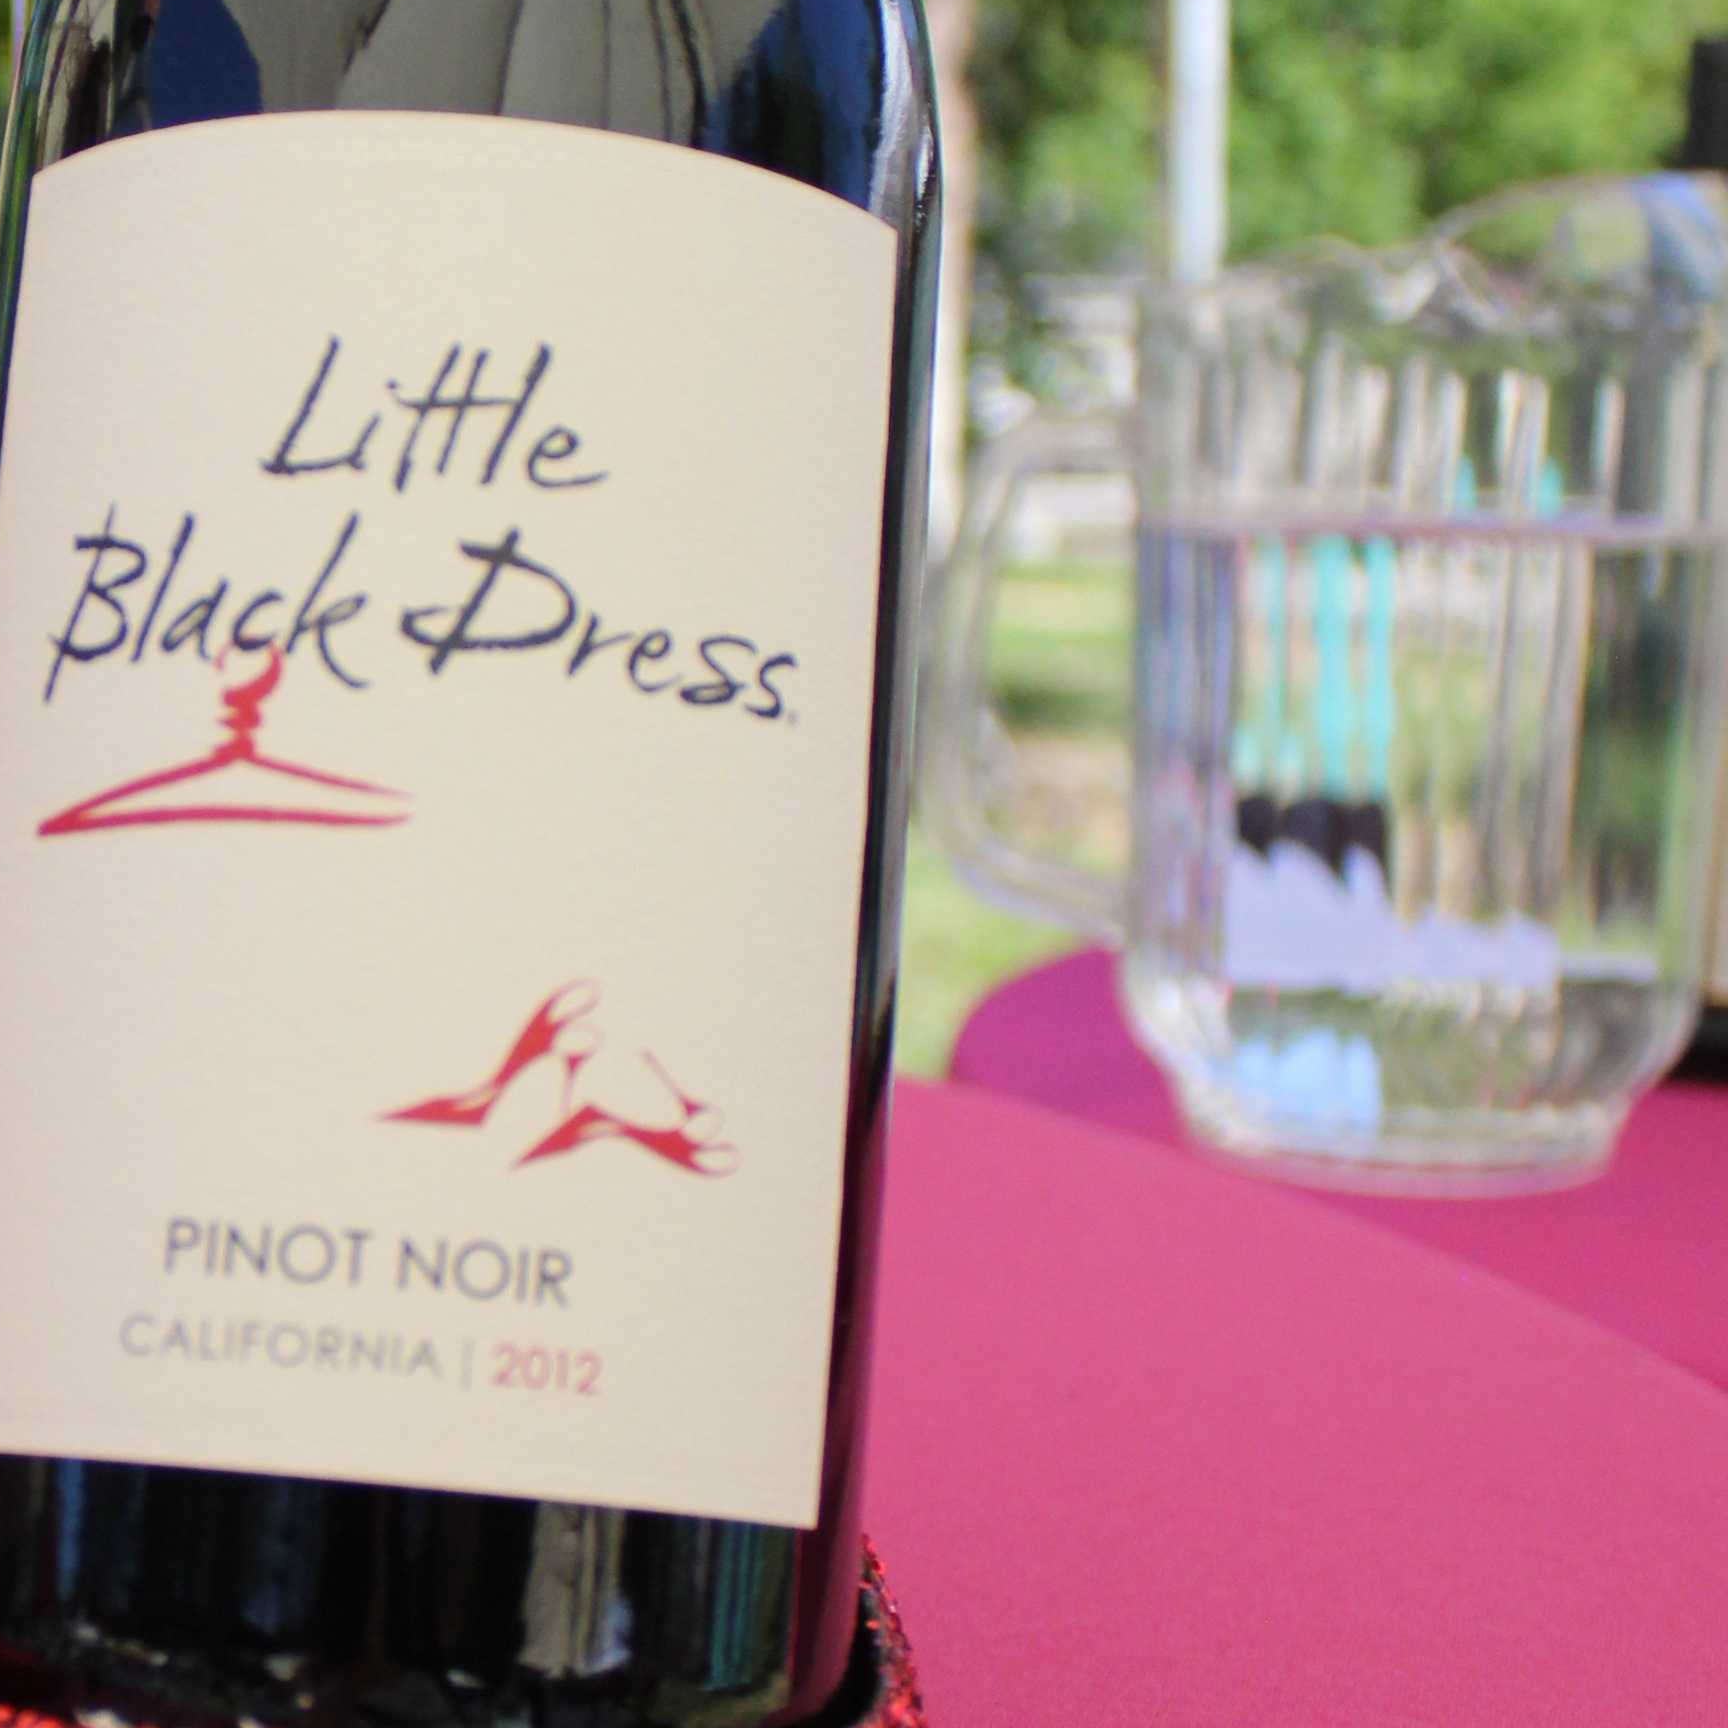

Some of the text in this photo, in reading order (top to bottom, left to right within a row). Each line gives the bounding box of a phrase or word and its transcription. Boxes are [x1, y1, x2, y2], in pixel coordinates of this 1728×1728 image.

[261, 335, 609, 492] Little
[45, 503, 798, 720] Black Dress
[163, 1216, 574, 1309] PINOT NOIR
[118, 1311, 604, 1396] CALIFORNIA 2012
